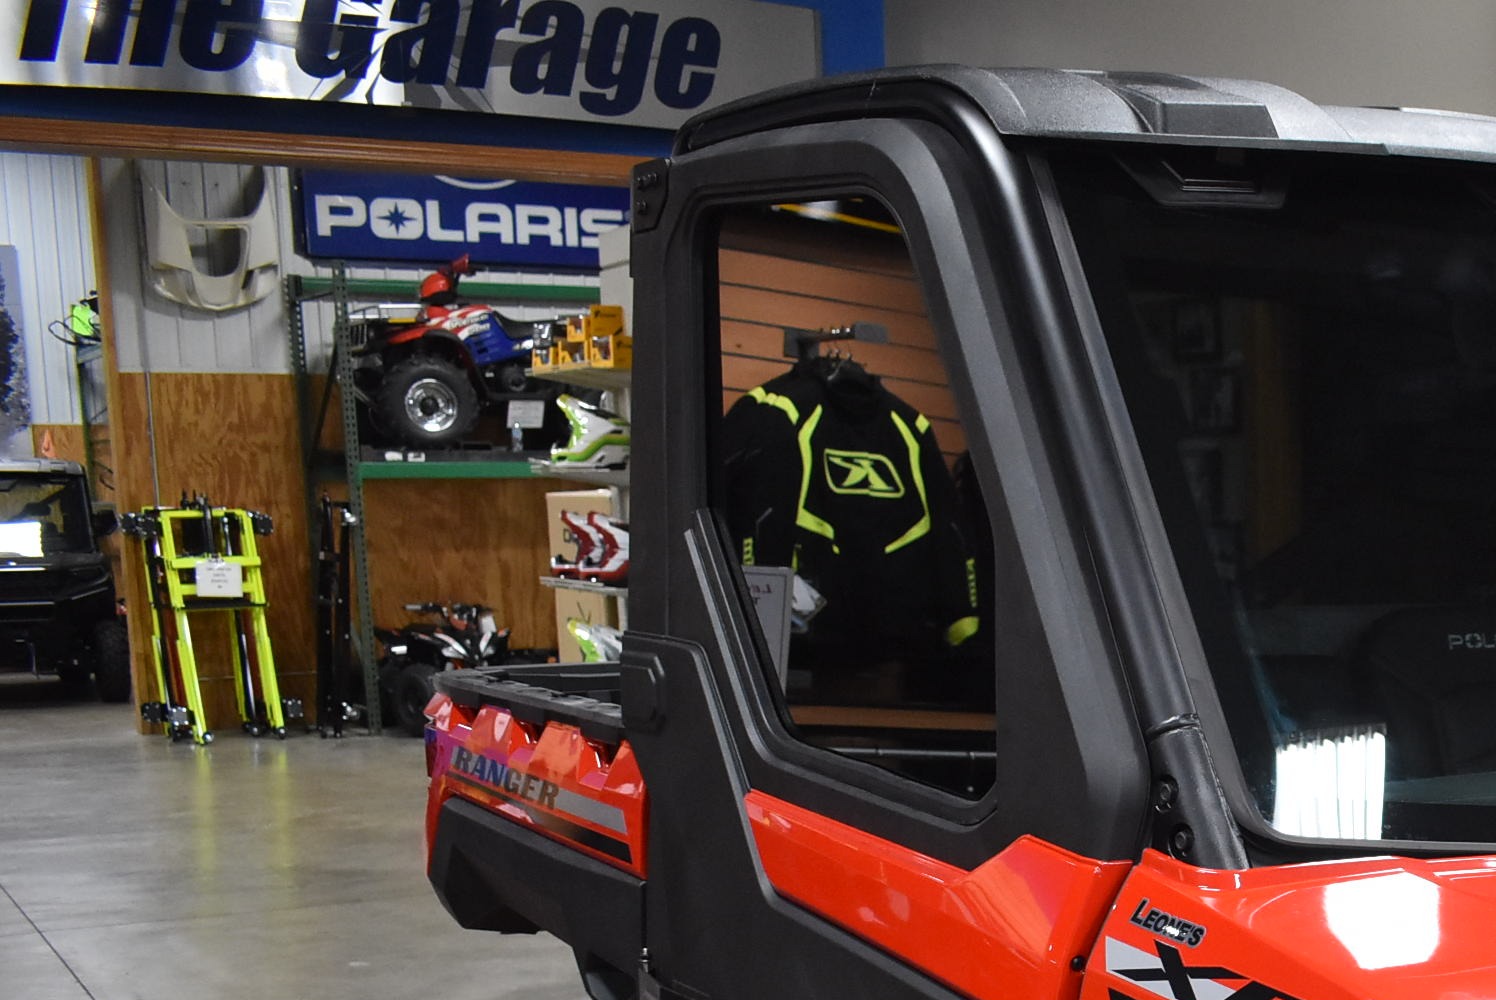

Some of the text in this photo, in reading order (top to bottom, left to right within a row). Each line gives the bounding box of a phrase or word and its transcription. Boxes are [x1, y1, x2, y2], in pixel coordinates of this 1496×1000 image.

[295, 0, 721, 116] Garage
[314, 194, 623, 248] POLARIS
[454, 745, 560, 810] RANGER
[1130, 898, 1206, 947] LEONE'S
